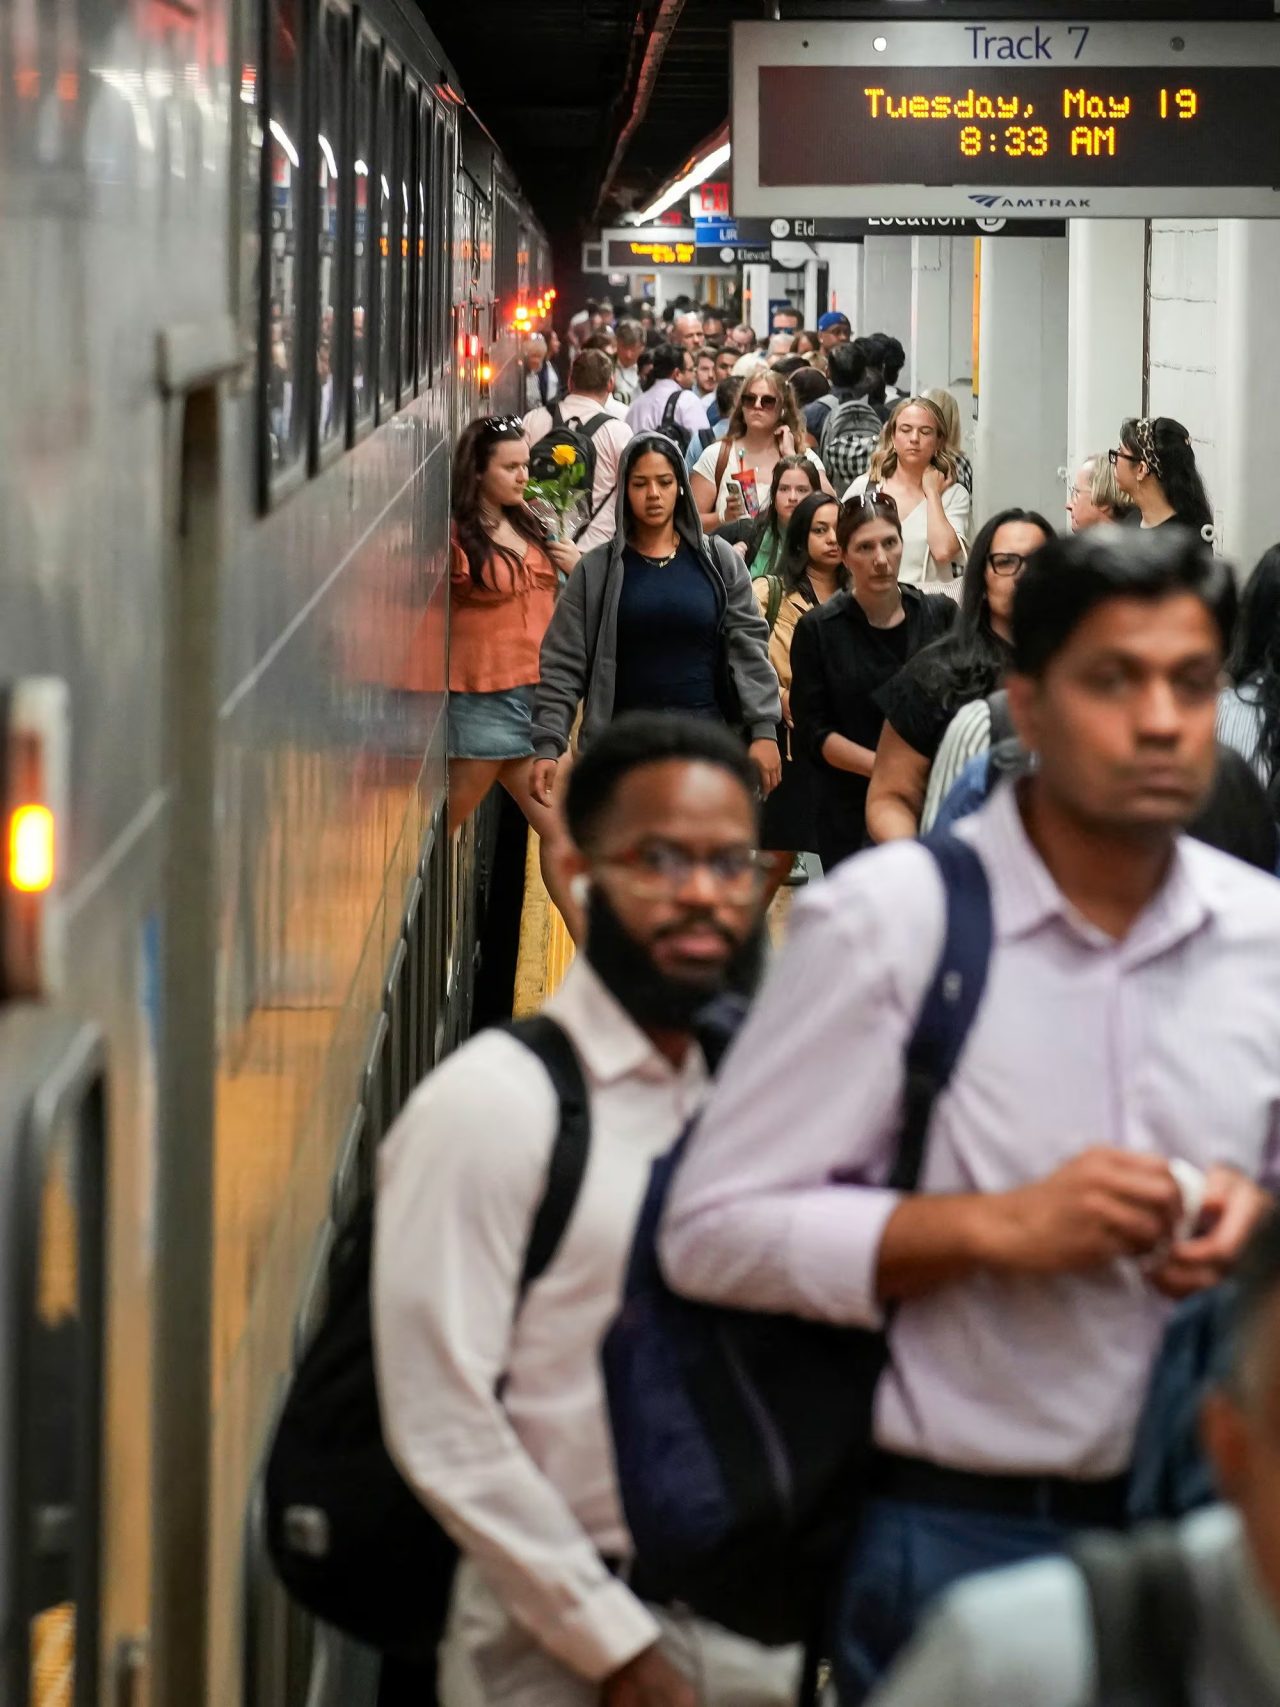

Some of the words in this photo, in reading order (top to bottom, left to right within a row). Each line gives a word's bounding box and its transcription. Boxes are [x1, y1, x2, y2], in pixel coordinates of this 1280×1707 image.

[964, 26, 1053, 60] Track
[1066, 26, 1090, 60] 7
[864, 88, 1035, 119] Tuesday,
[1063, 89, 1130, 118] May
[1159, 89, 1197, 118] 19
[960, 126, 1048, 156] 8:33
[1071, 126, 1116, 156] AM
[702, 182, 731, 211] EXI
[1001, 198, 1091, 208] AMTRAK
